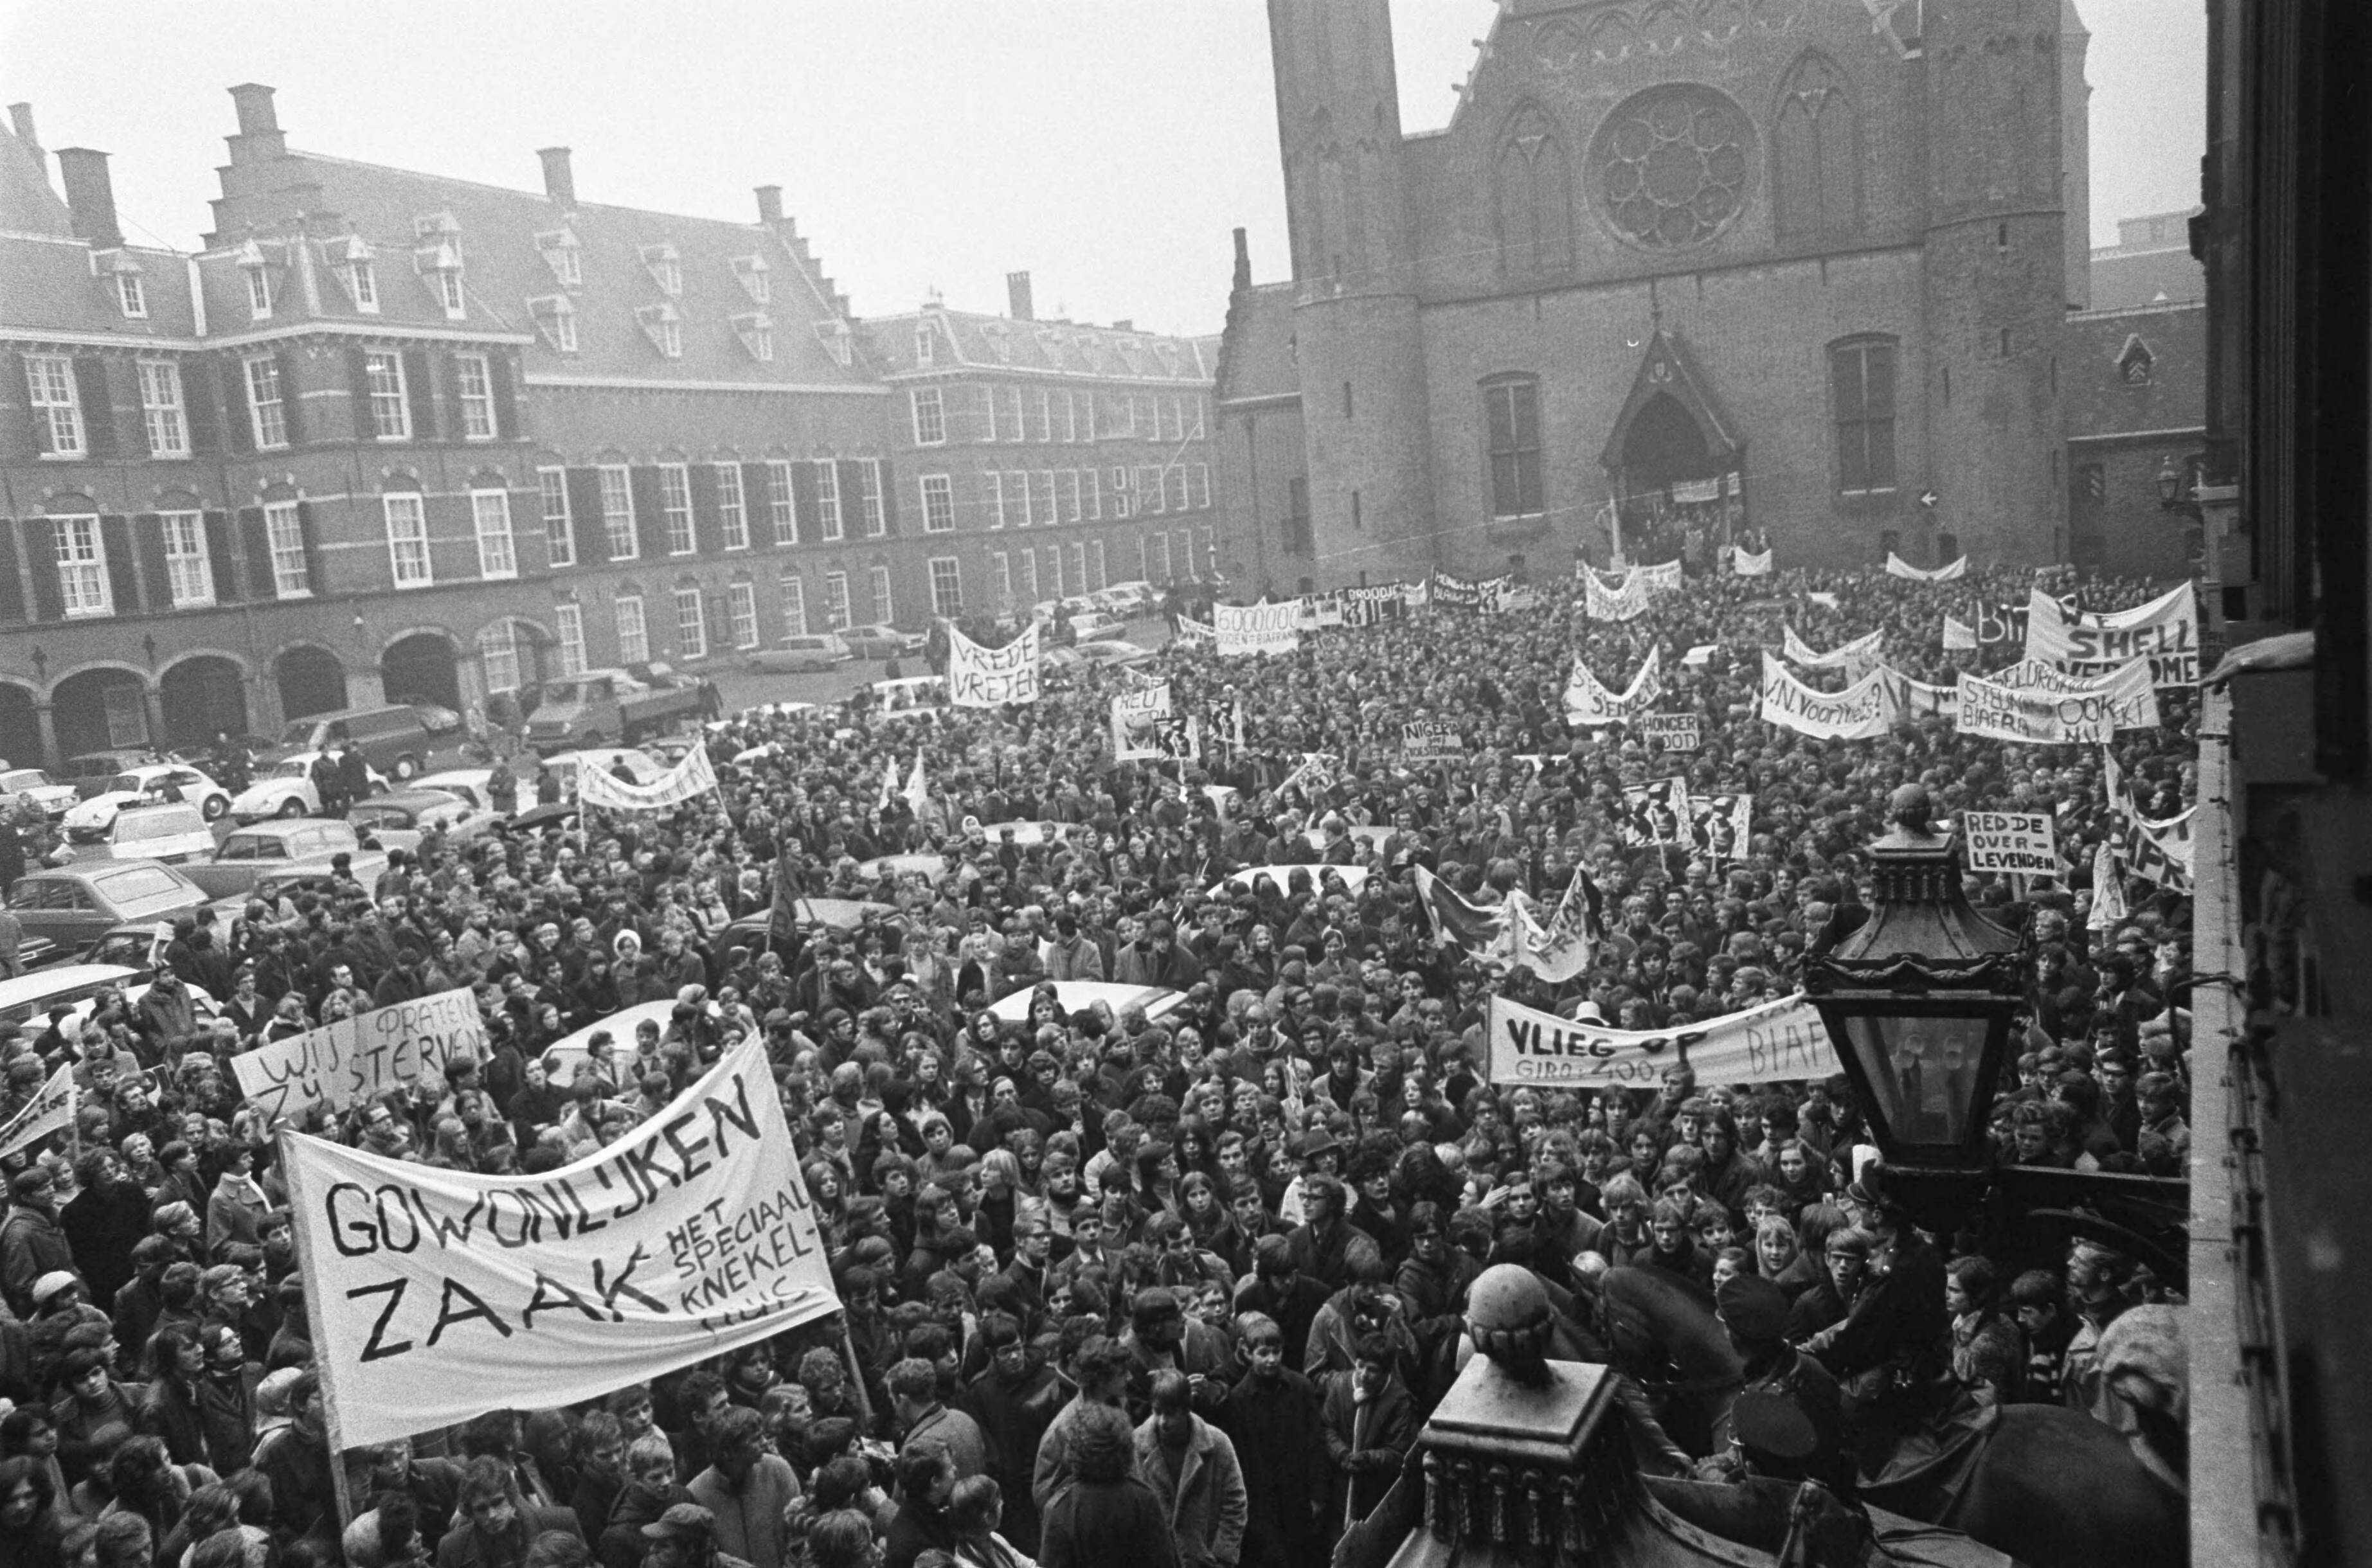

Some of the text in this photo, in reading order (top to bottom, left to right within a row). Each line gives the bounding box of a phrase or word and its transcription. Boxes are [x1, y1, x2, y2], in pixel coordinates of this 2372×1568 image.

[1218, 605, 1300, 632] 6000000
[953, 633, 1035, 670] VREDE
[2068, 619, 2197, 659] SHELL
[2056, 655, 2198, 684] VEROME
[1963, 704, 2100, 743] BIAFRA NU
[2058, 695, 2116, 725] OOK
[1968, 814, 2045, 834] RED DE
[1973, 851, 2056, 871] LEVENDEN
[1506, 1019, 1617, 1057] VLIEG
[1746, 1020, 1834, 1076] BIAF
[666, 1197, 725, 1254] HET
[674, 1179, 811, 1279] SPECIAAL
[680, 1222, 816, 1315] KNEKEL-
[346, 1242, 669, 1362] ZAAK
